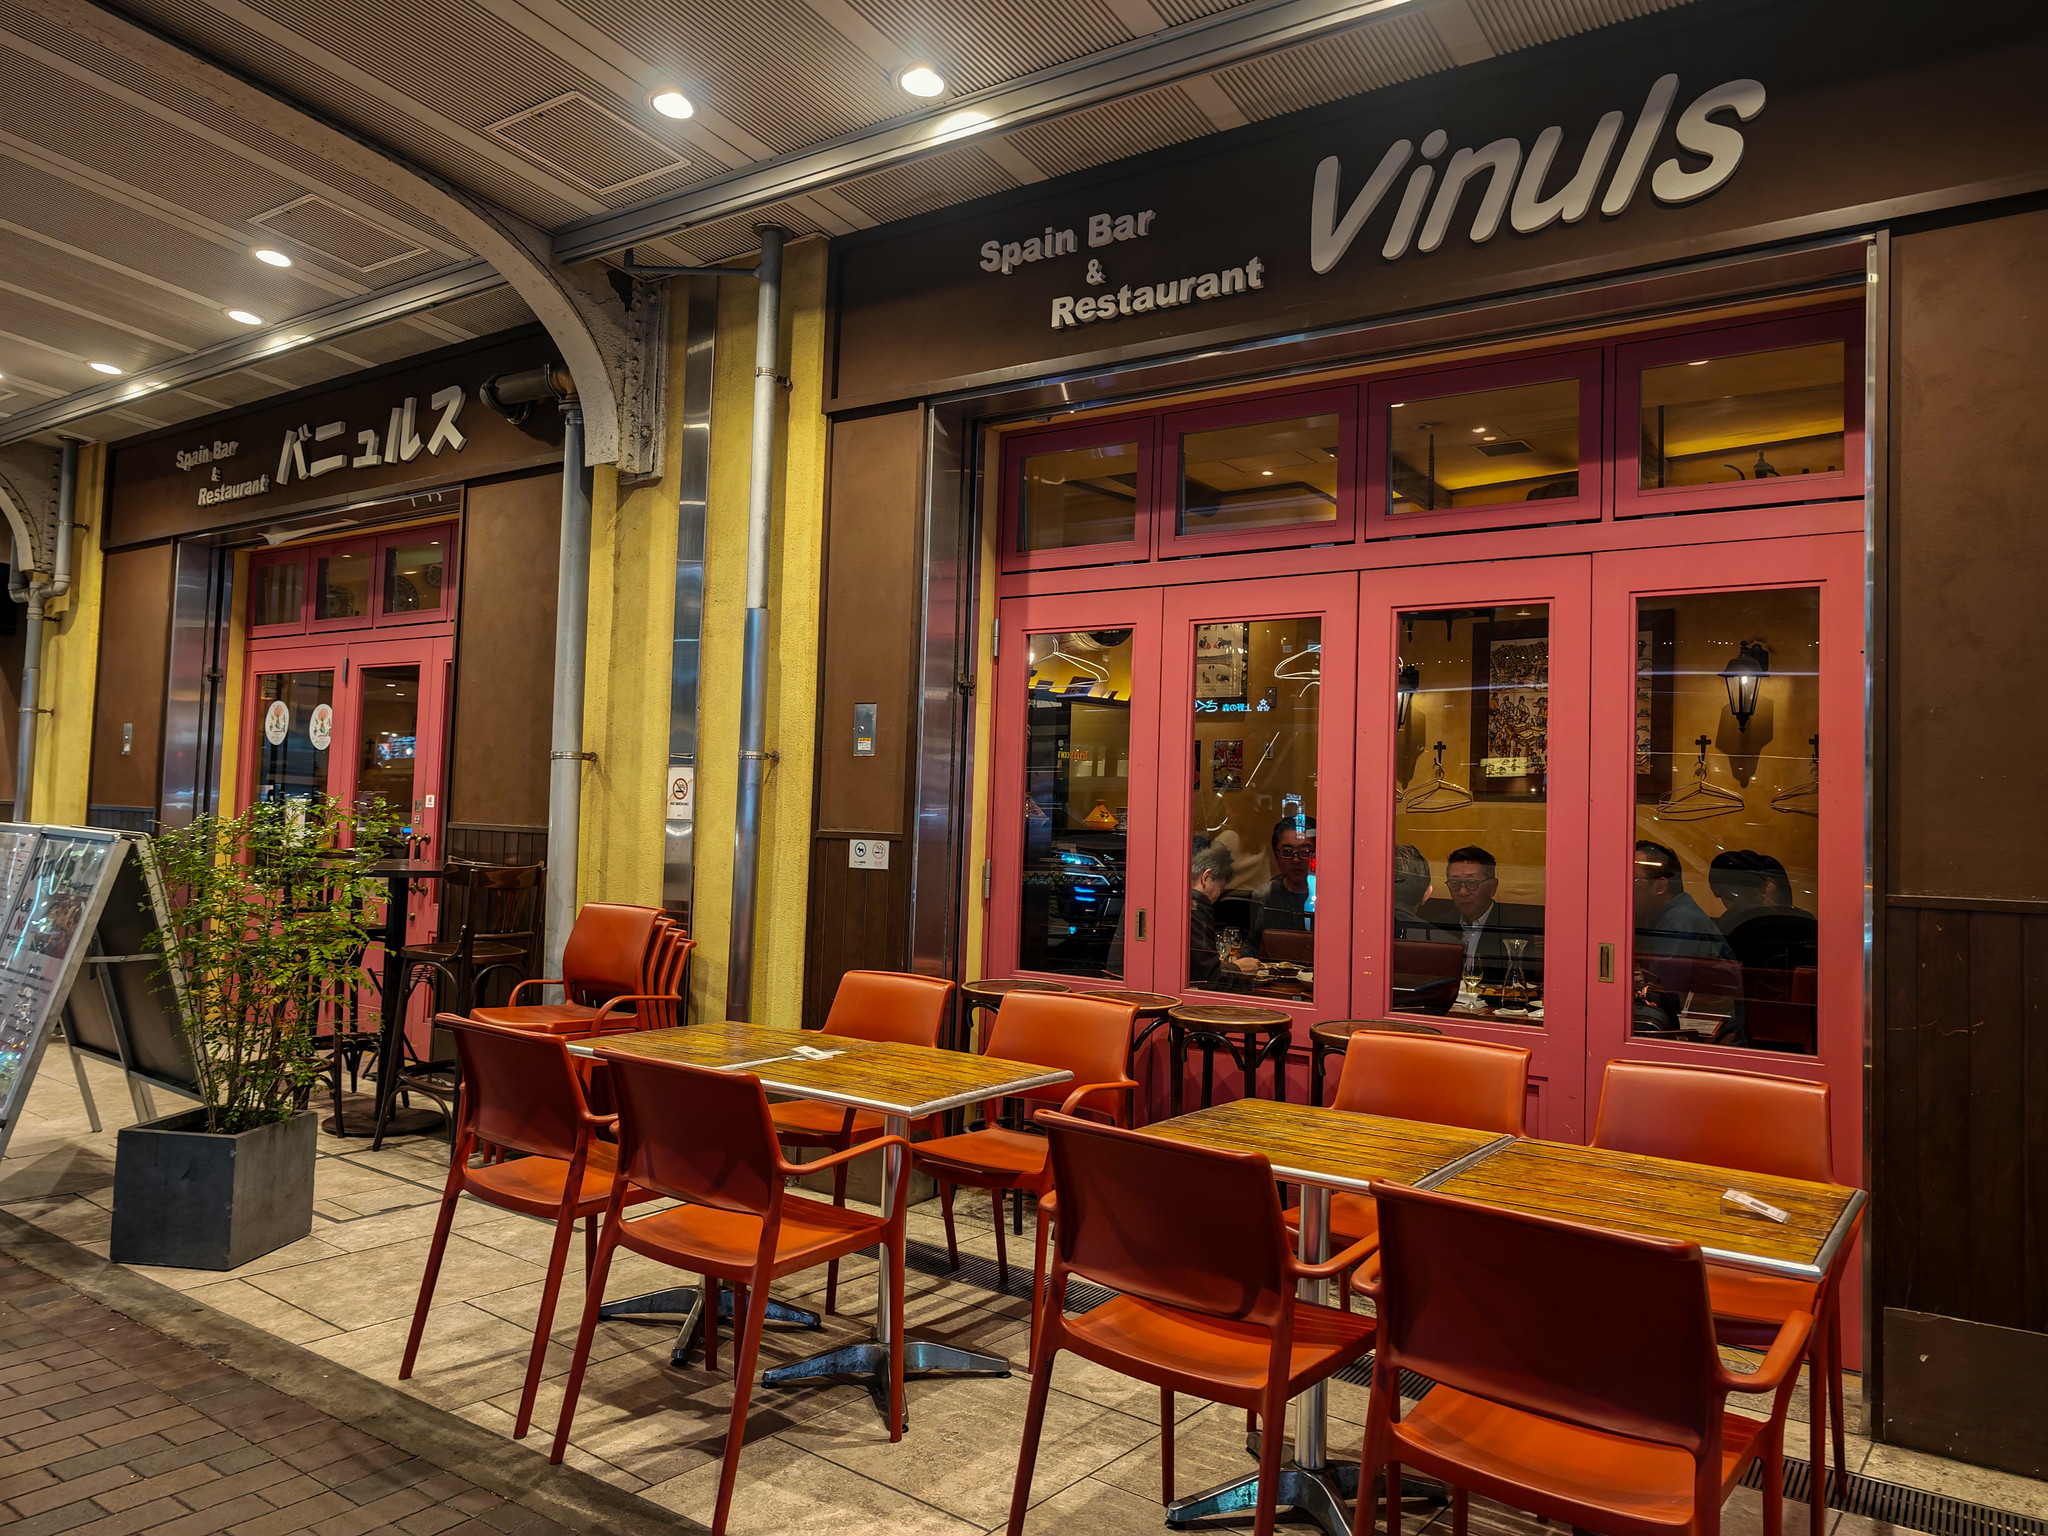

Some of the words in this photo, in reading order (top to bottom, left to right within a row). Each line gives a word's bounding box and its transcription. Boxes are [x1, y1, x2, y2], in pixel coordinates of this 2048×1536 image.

[1310, 73, 1767, 275] Vinuls
[980, 227, 1078, 275] Spain
[1088, 209, 1156, 248] Bar
[1051, 256, 1265, 329] Restaurant
[1086, 258, 1106, 286] &
[176, 444, 213, 471] Spain
[212, 440, 239, 460] Bar
[276, 385, 468, 486] バニュルス
[197, 474, 270, 507] Restaurant
[211, 466, 222, 482] &
